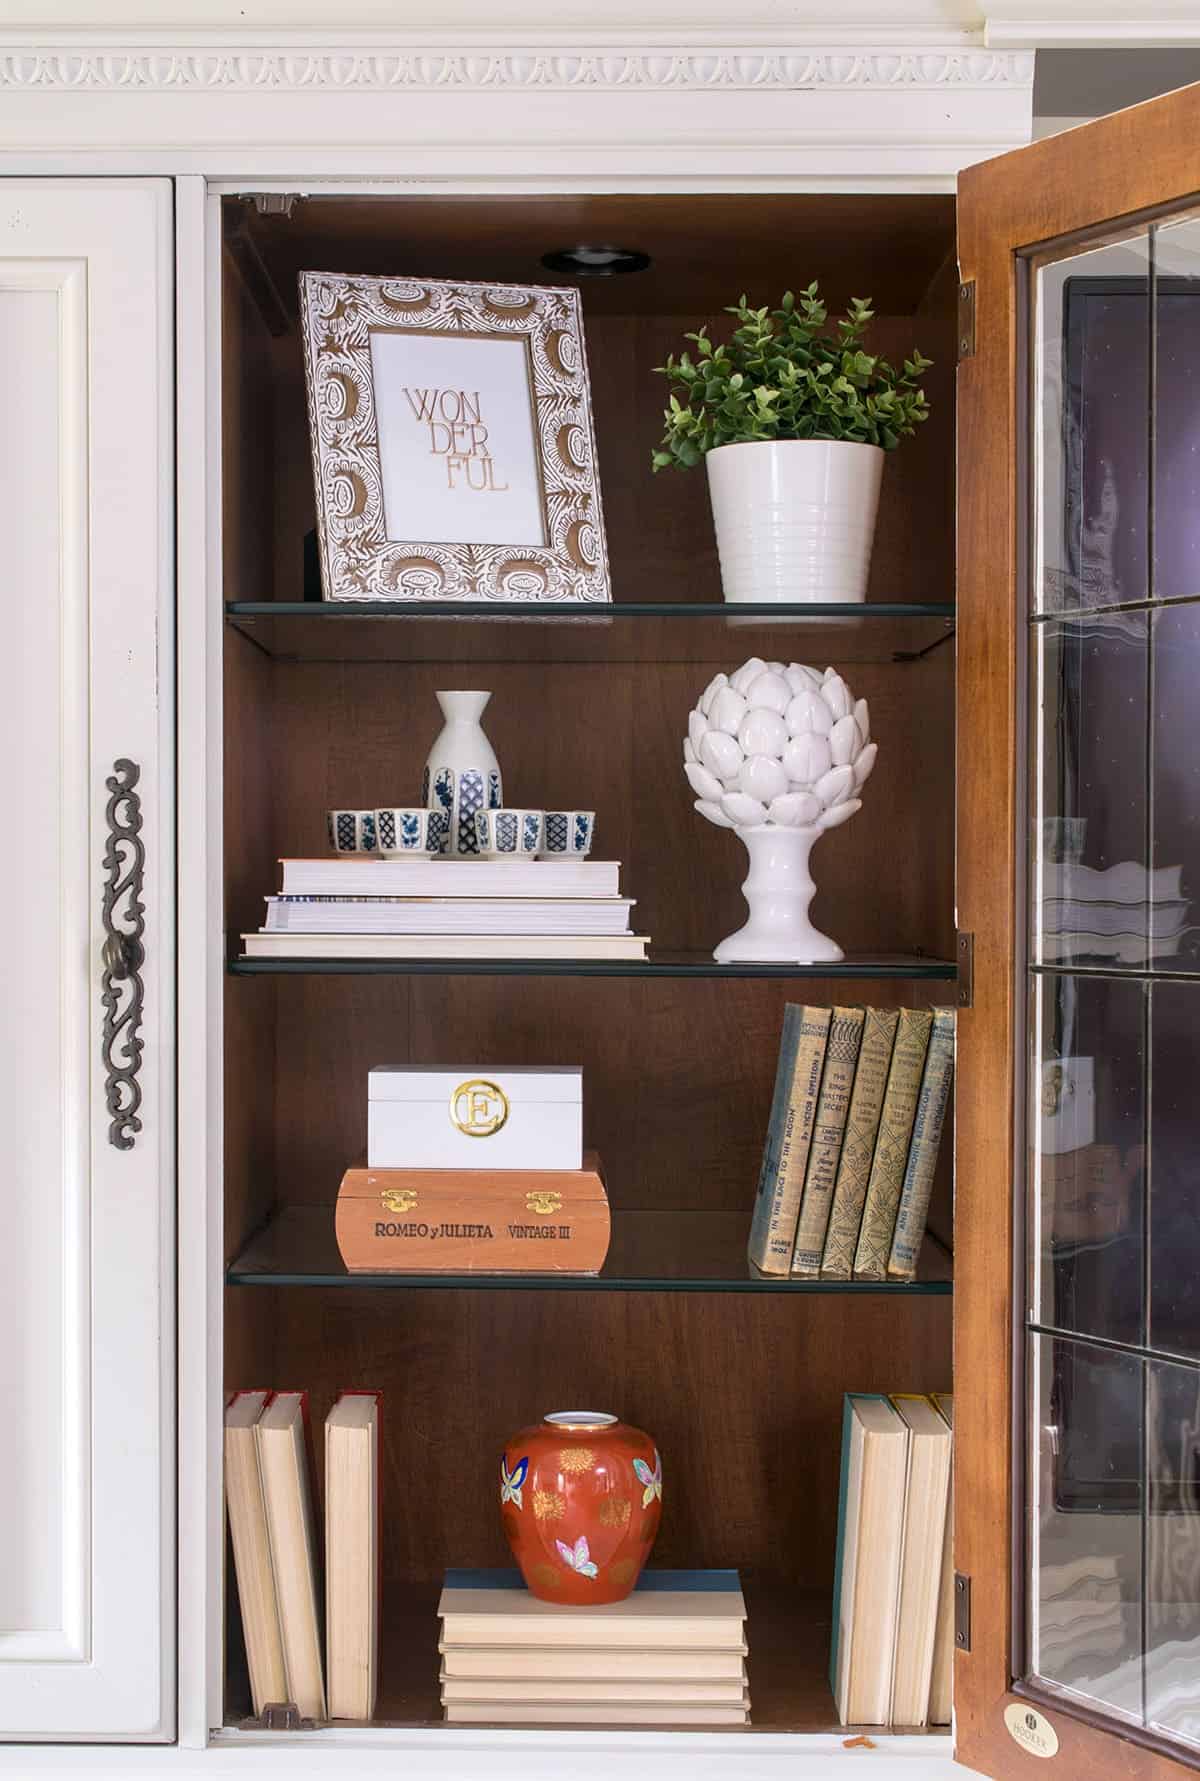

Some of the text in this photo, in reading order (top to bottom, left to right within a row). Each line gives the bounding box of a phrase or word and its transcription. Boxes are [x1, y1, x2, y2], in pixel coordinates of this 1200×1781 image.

[401, 387, 482, 424] WON
[430, 422, 490, 456] DER
[447, 456, 510, 491] FUL
[375, 1223, 427, 1238] ROMEO
[438, 1224, 493, 1239] JULIETA
[508, 1225, 557, 1239] VINTAGE
